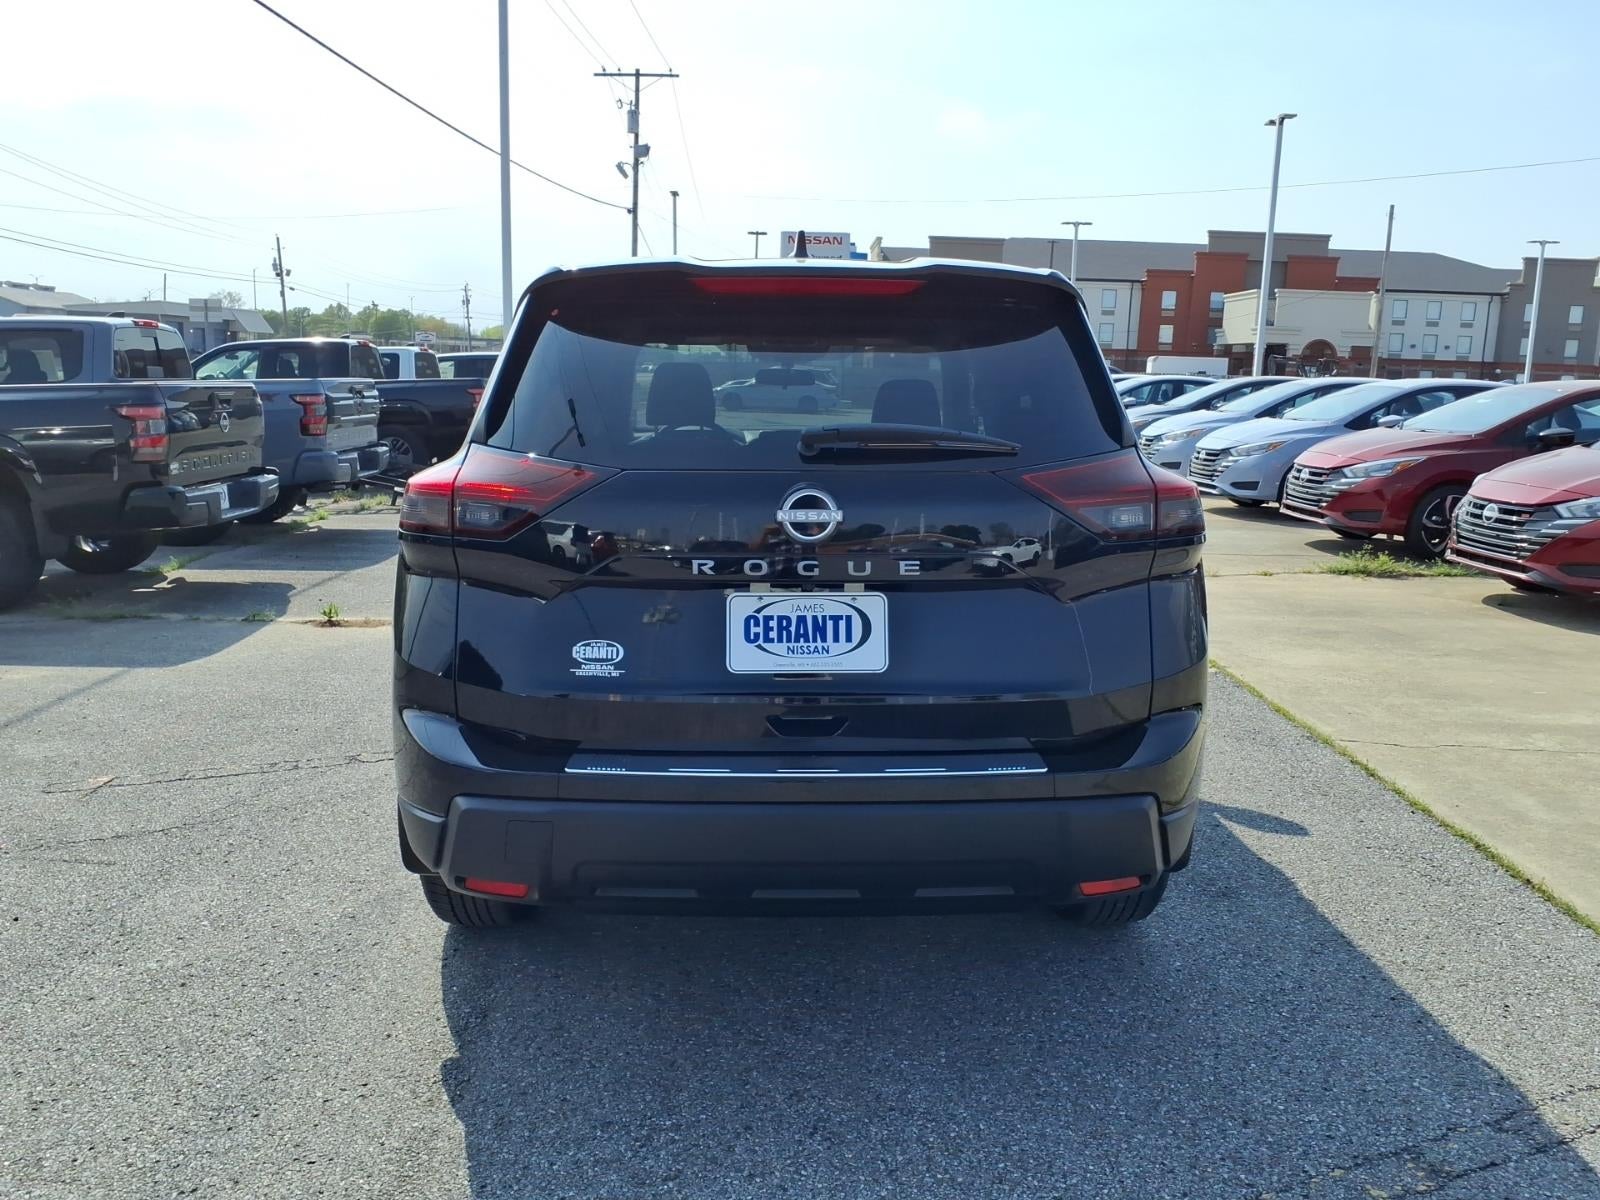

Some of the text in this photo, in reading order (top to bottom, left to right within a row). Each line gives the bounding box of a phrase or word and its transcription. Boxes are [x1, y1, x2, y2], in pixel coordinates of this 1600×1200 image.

[788, 235, 843, 245] NSSAN
[779, 511, 841, 520] NISSAN
[691, 559, 921, 576] ROGUE
[790, 604, 825, 613] JAMES
[743, 614, 853, 644] CERANTI
[572, 646, 617, 659] CERANTI
[787, 645, 830, 655] NISSAN
